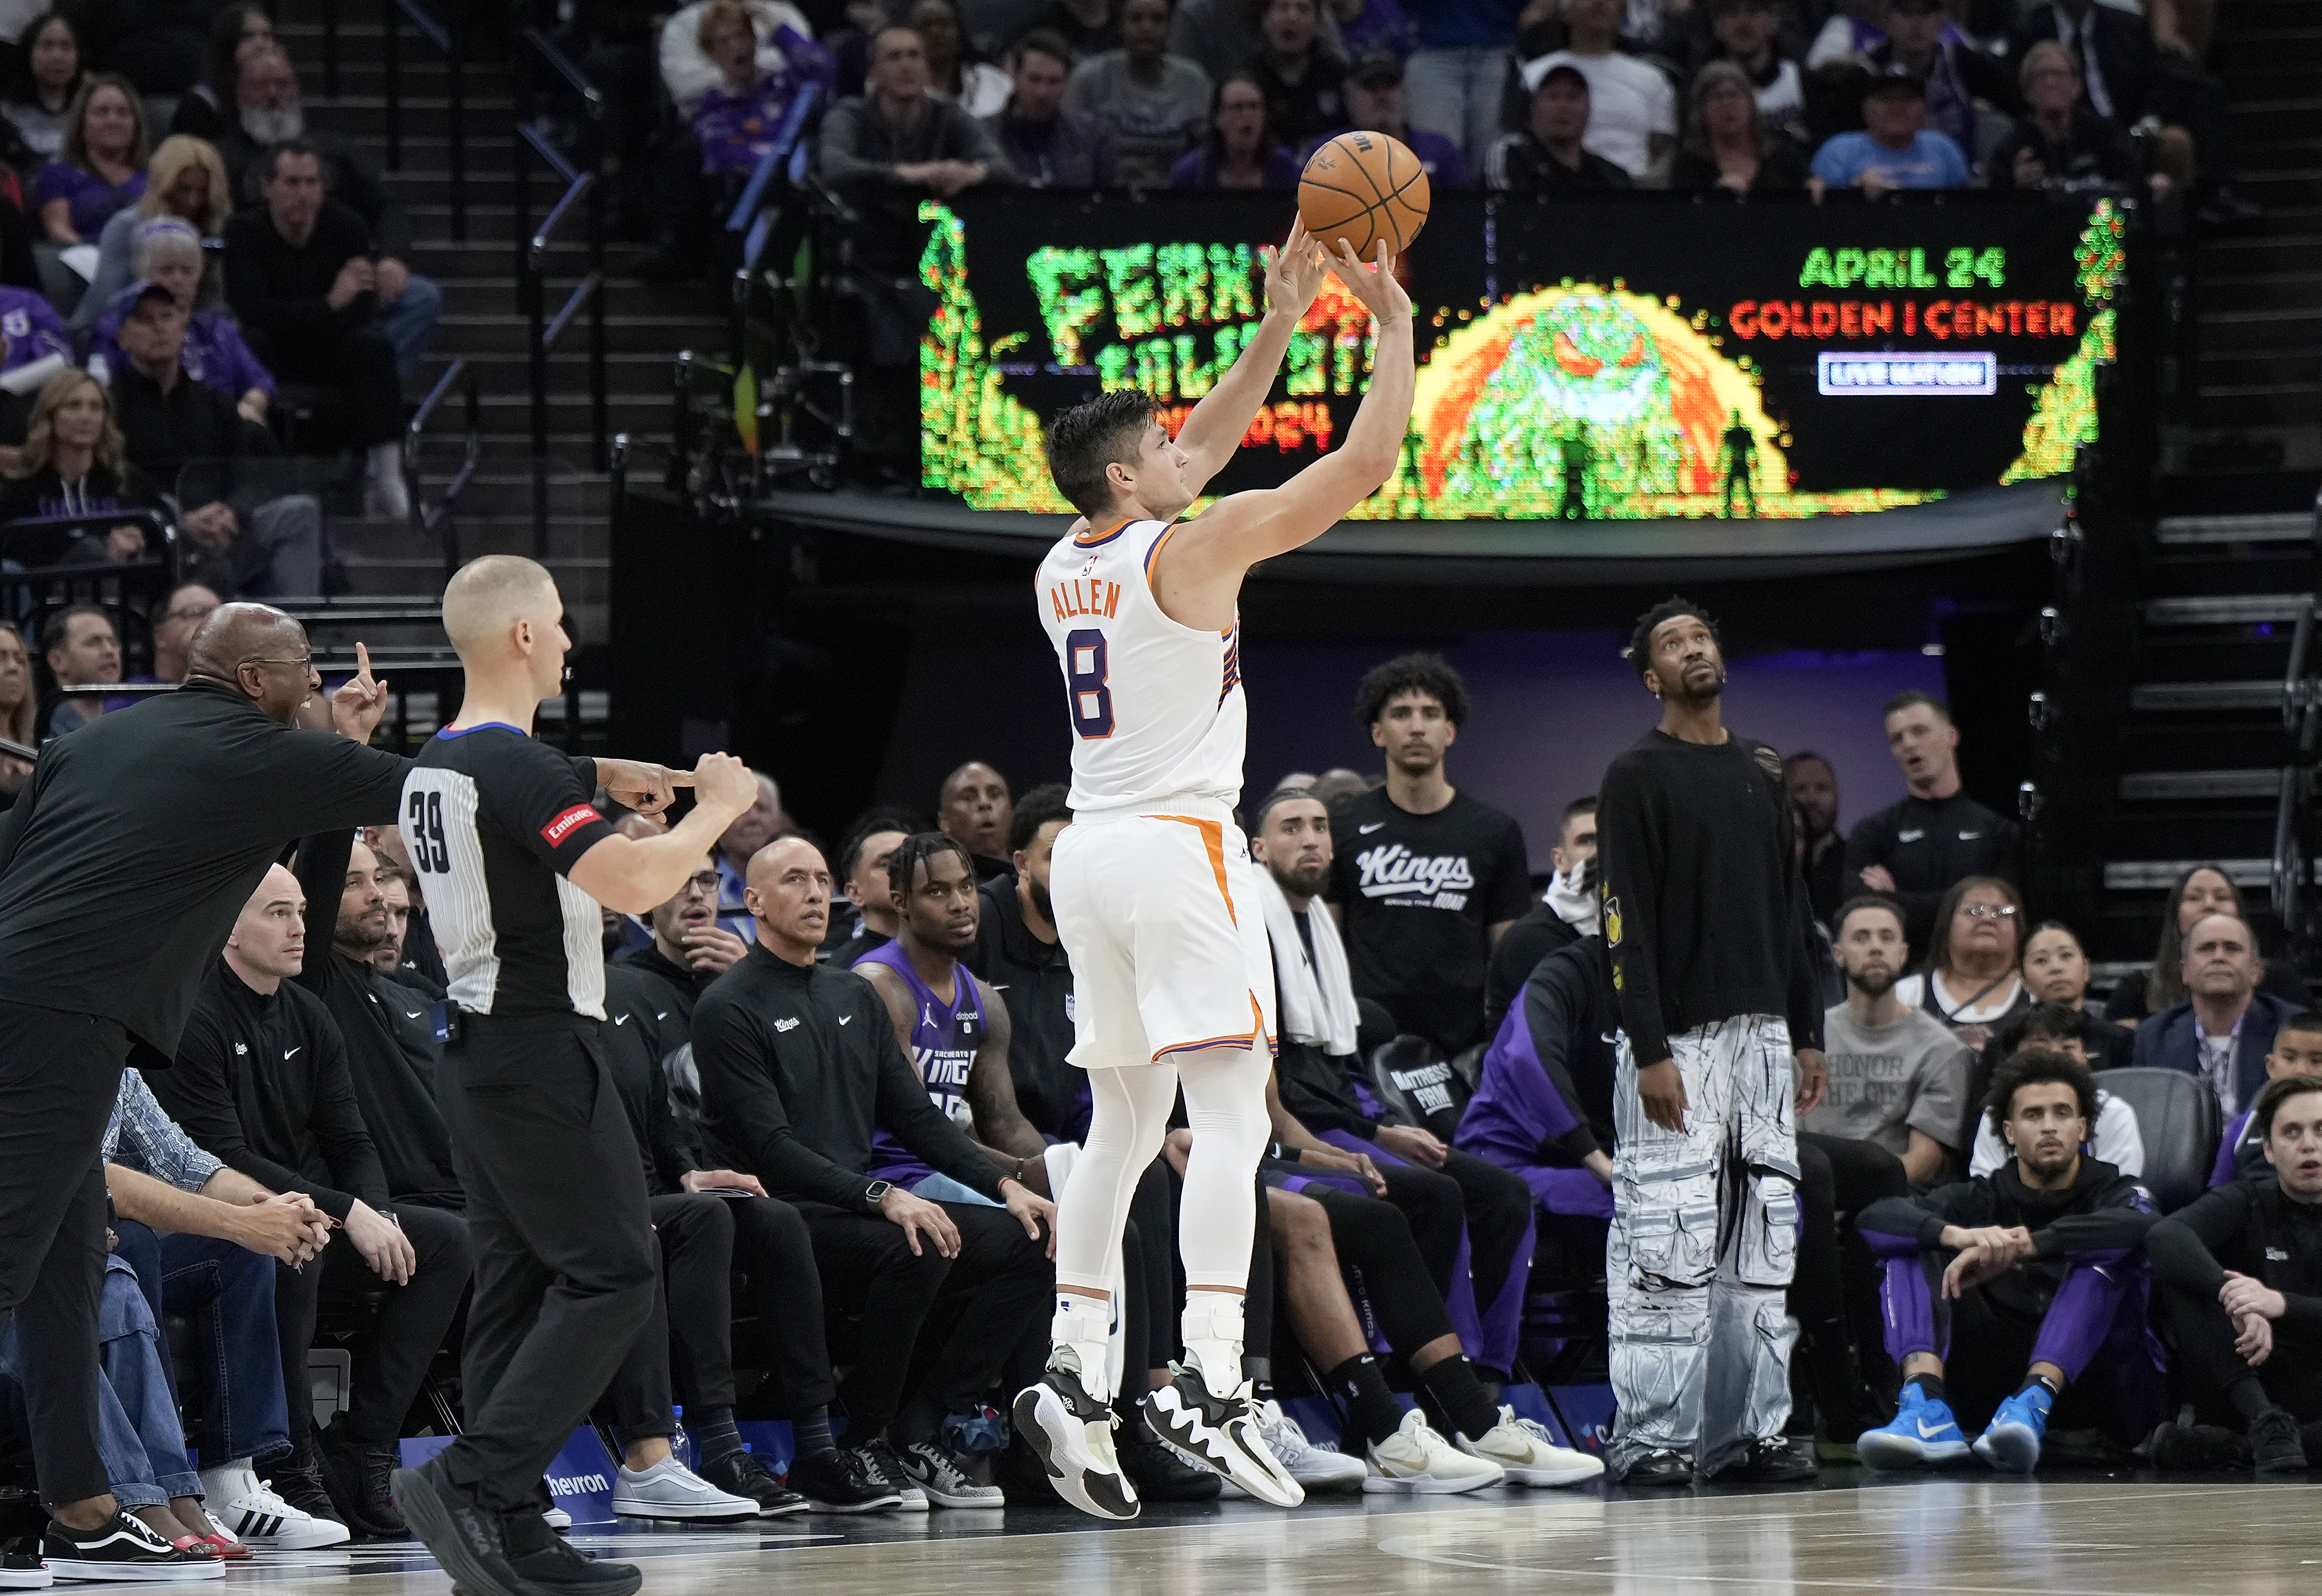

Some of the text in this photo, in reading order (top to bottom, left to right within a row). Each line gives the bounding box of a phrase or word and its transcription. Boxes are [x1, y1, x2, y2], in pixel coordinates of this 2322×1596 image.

[1799, 247, 2005, 288] APRIL 24
[1729, 300, 1893, 340] GOLDEN
[1924, 300, 2076, 340] CENTER
[1051, 579, 1121, 623] ALLEN
[1066, 628, 1116, 740] 8
[409, 791, 450, 873] 39
[548, 808, 595, 839] Emirates
[1356, 844, 1474, 898] Kings
[774, 1017, 800, 1033] Kings
[1390, 1061, 1452, 1092] MATTRESS
[1413, 1082, 1451, 1109] FIRM
[1823, 1082, 1858, 1107] HE
